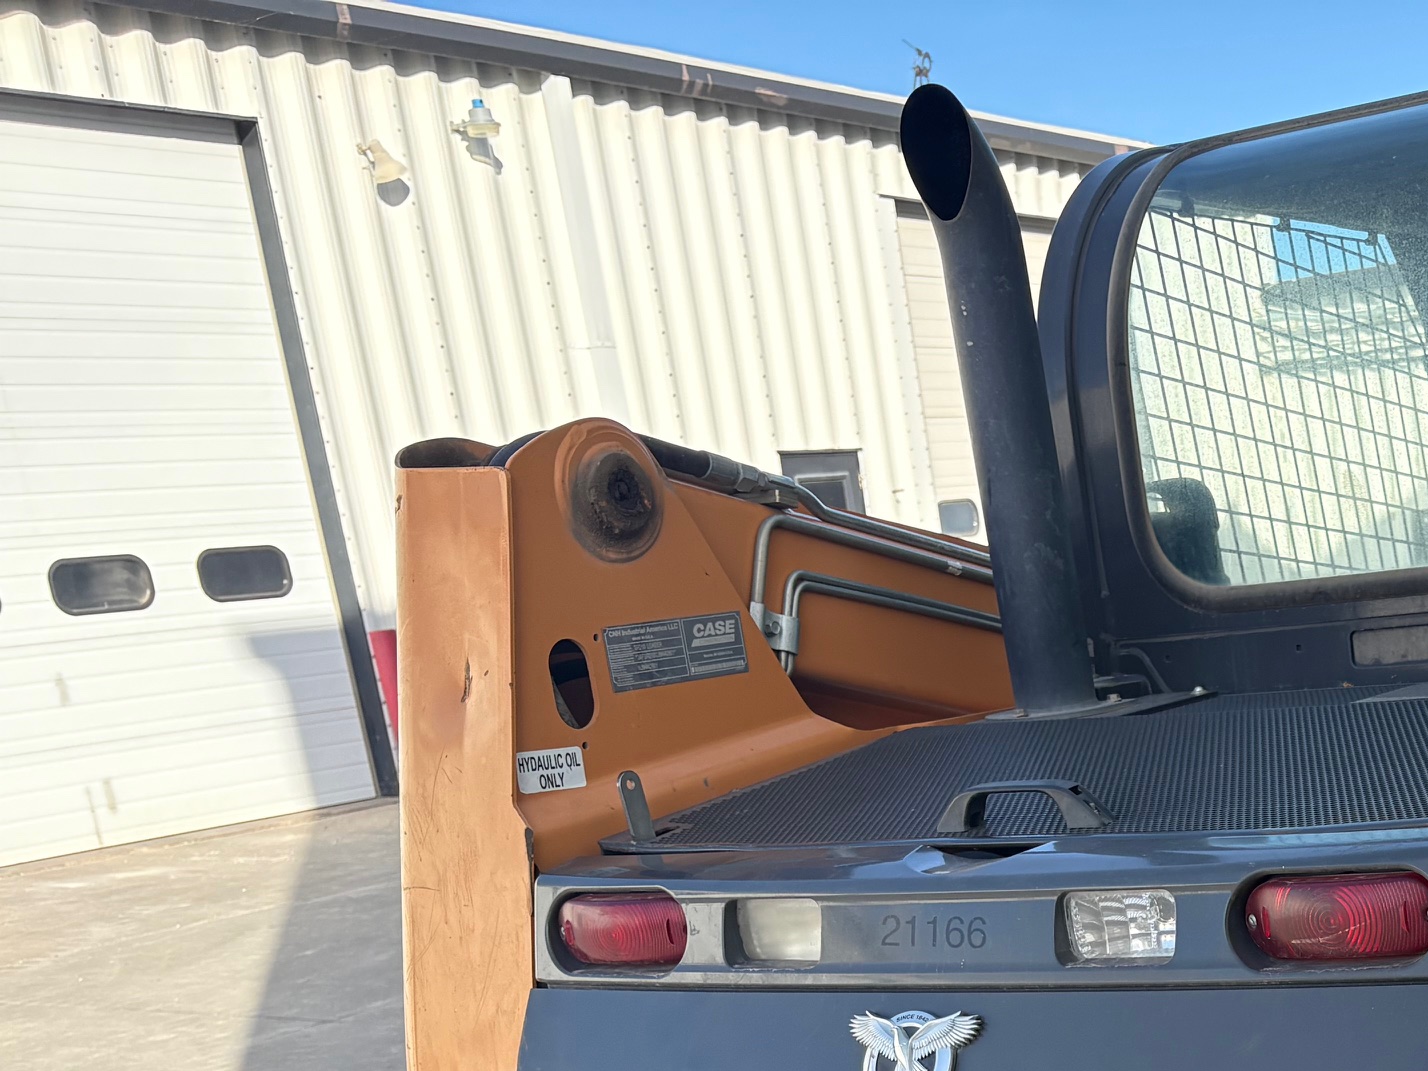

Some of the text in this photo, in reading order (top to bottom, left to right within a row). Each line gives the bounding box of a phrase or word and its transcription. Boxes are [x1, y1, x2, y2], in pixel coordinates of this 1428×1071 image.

[621, 626, 646, 636] Industrial
[646, 624, 668, 633] America
[667, 622, 679, 631] LLC
[692, 619, 736, 638] CASE
[517, 753, 564, 774] HYDAULIC
[539, 771, 565, 790] ONLY
[880, 913, 988, 950] 21166
[896, 1013, 916, 1023] SINCE
